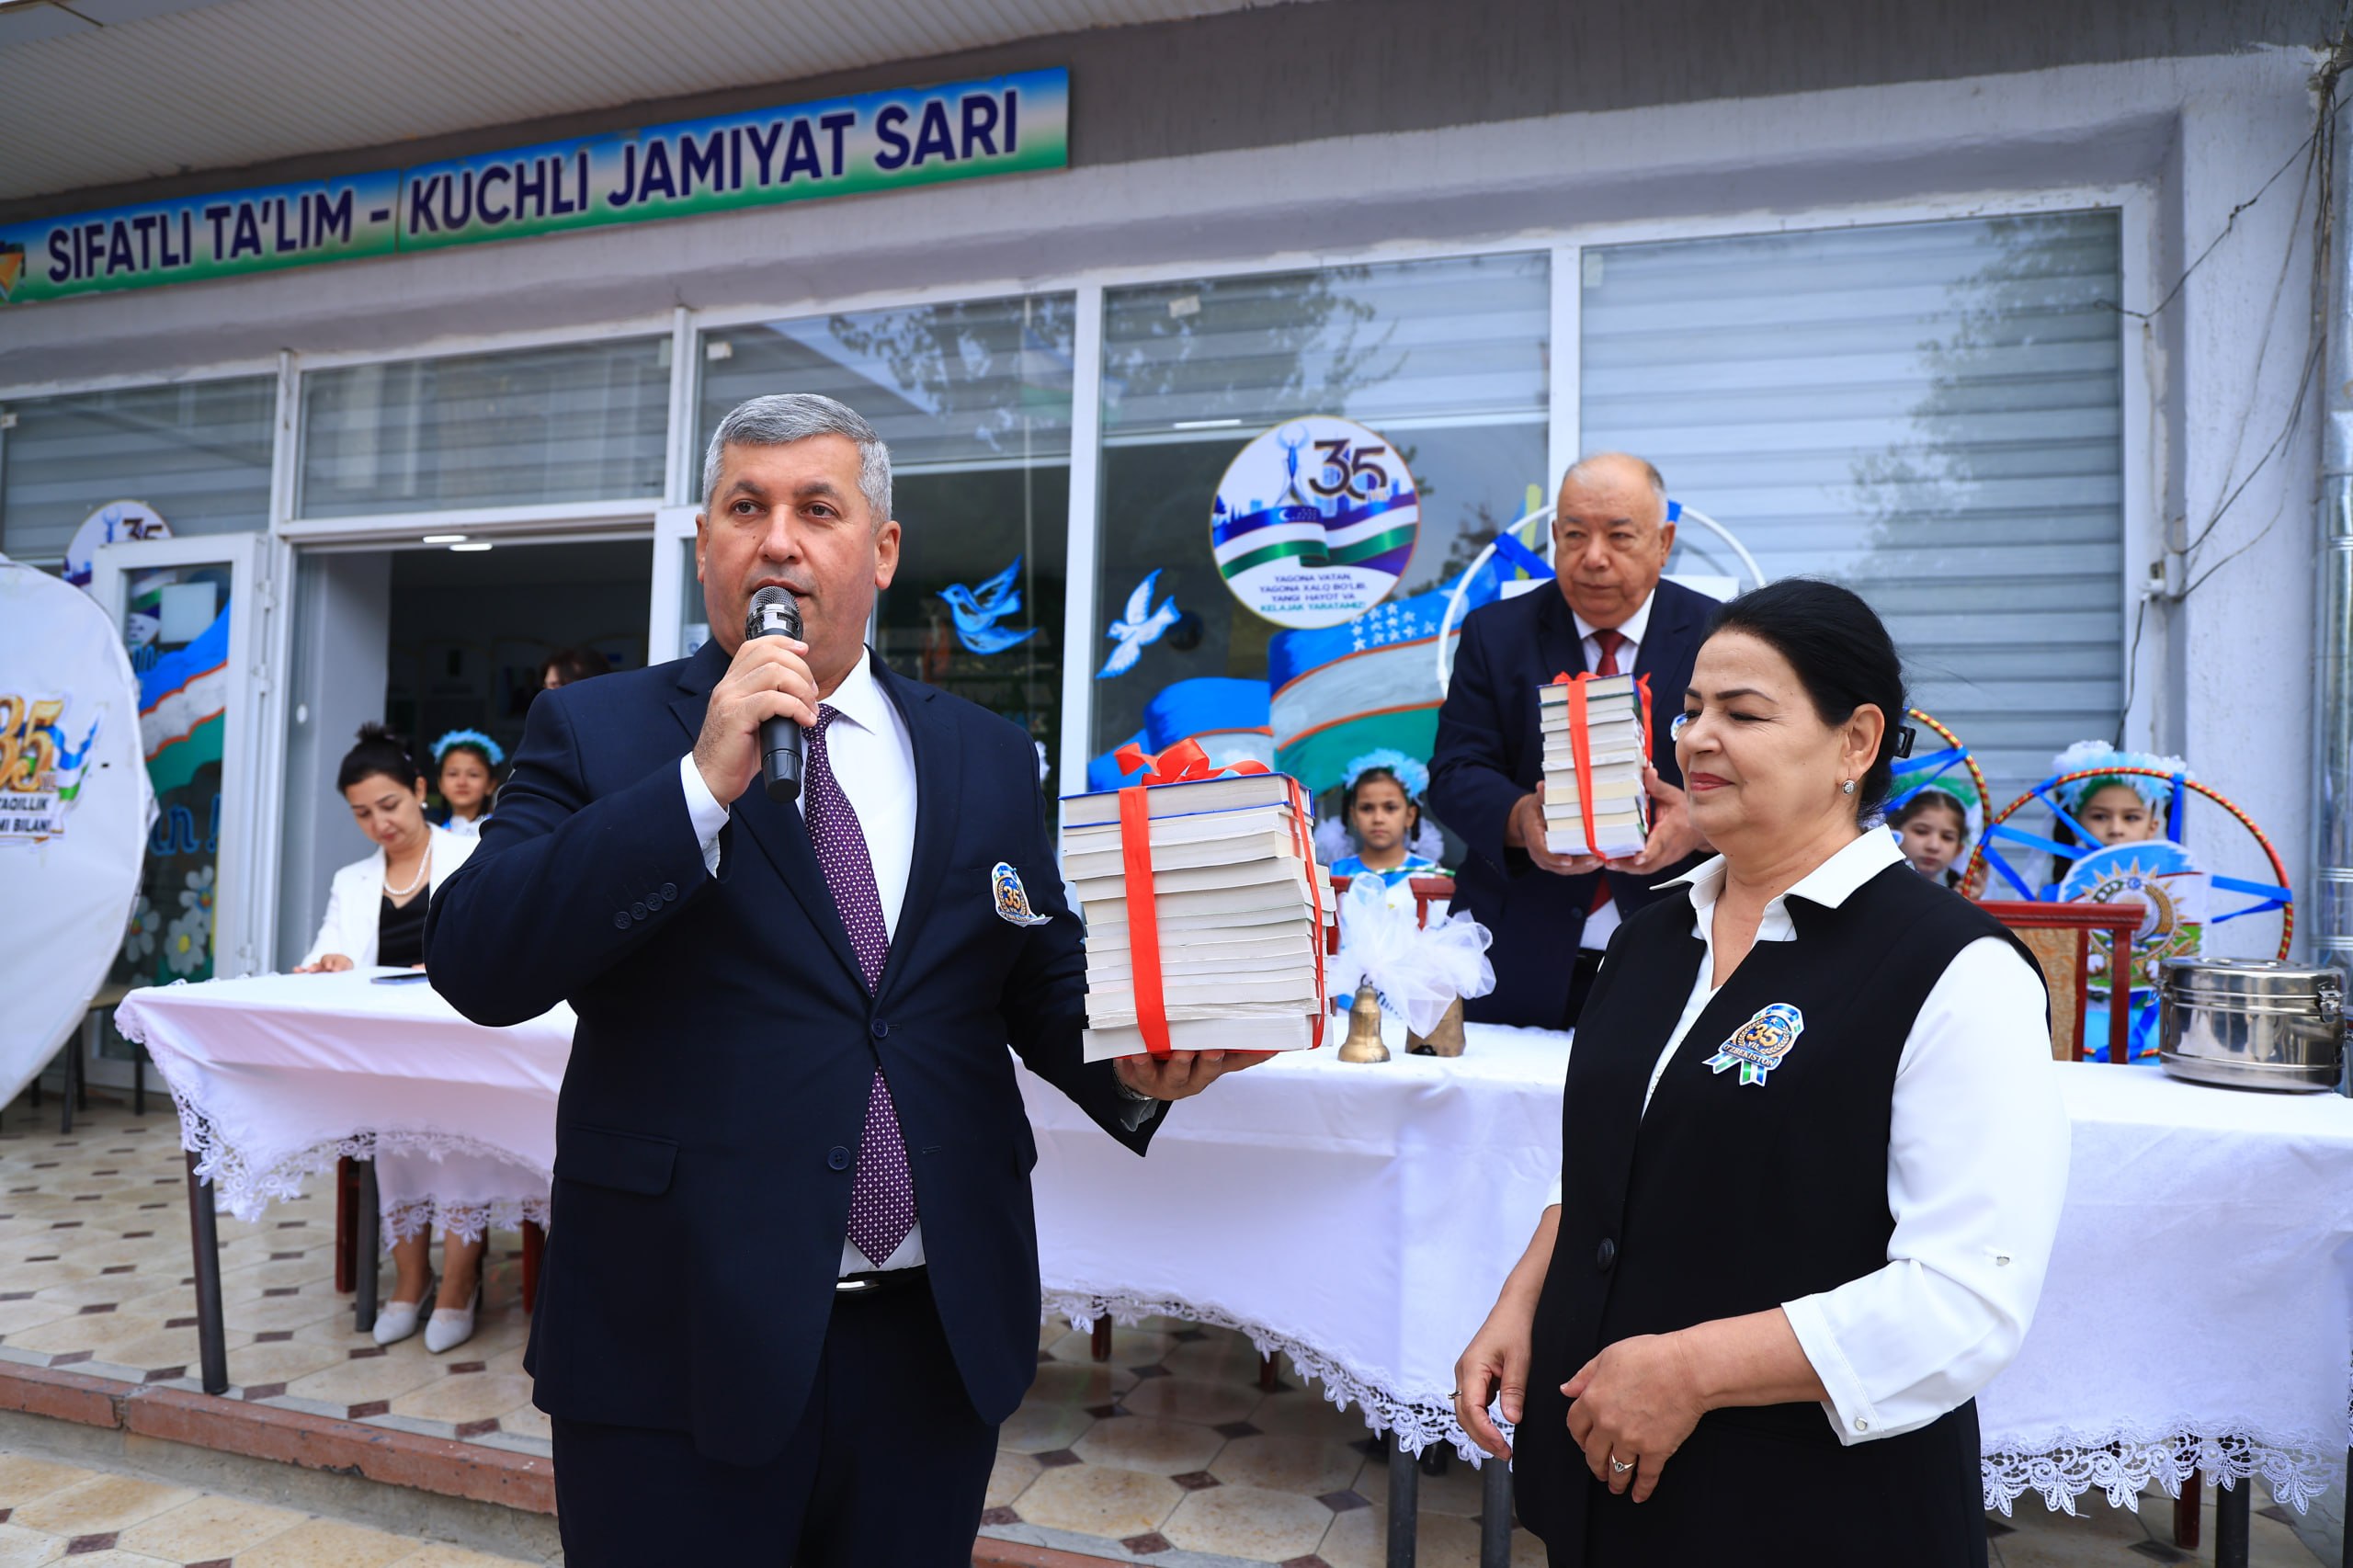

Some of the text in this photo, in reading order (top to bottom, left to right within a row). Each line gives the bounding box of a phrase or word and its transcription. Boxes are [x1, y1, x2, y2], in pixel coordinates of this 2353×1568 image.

[48, 210, 192, 283] SIFATLI
[408, 152, 588, 234] KUCHLI
[608, 112, 856, 207] JAMIYAT
[874, 90, 1017, 170] SARI
[1309, 438, 1388, 500] 35
[1003, 885, 1022, 910] 35
[1746, 1023, 1783, 1047] 35
[1748, 1041, 1761, 1051] YIL
